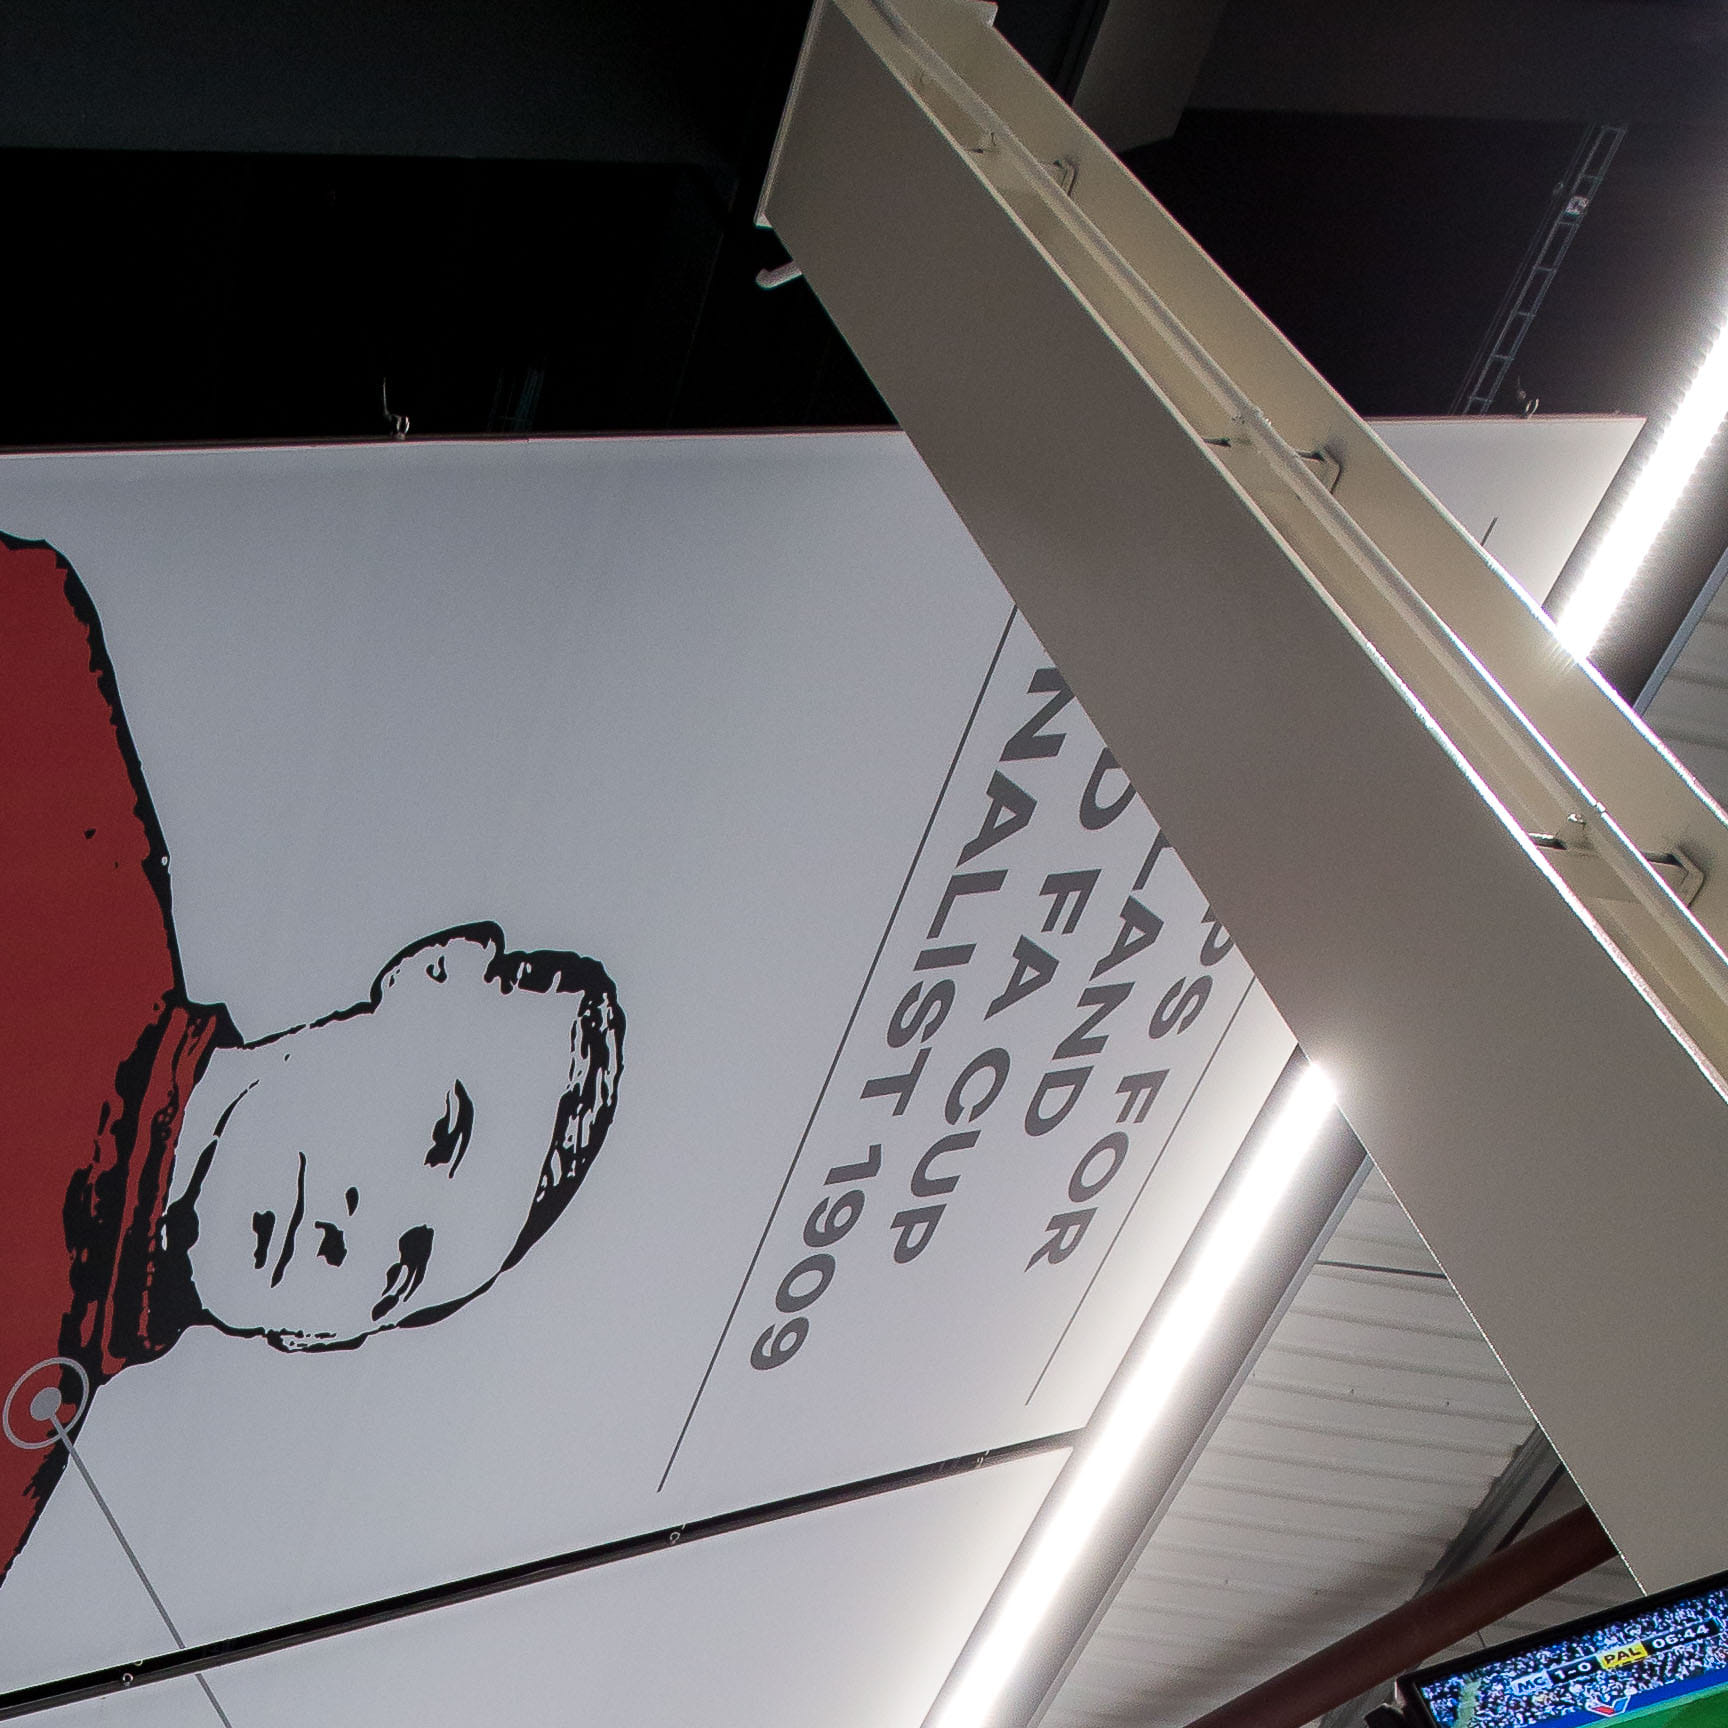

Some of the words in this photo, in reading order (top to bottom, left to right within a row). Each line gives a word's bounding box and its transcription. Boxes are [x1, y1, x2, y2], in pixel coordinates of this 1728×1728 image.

[861, 667, 1076, 1118] NALIST
[984, 868, 1102, 1021] FA
[750, 1144, 882, 1372] 1909
[891, 1048, 1010, 1265] CUP
[1025, 1066, 1170, 1273] FOR
[1604, 1647, 1642, 1664] PAL
[1651, 1625, 1709, 1650] 06:44
